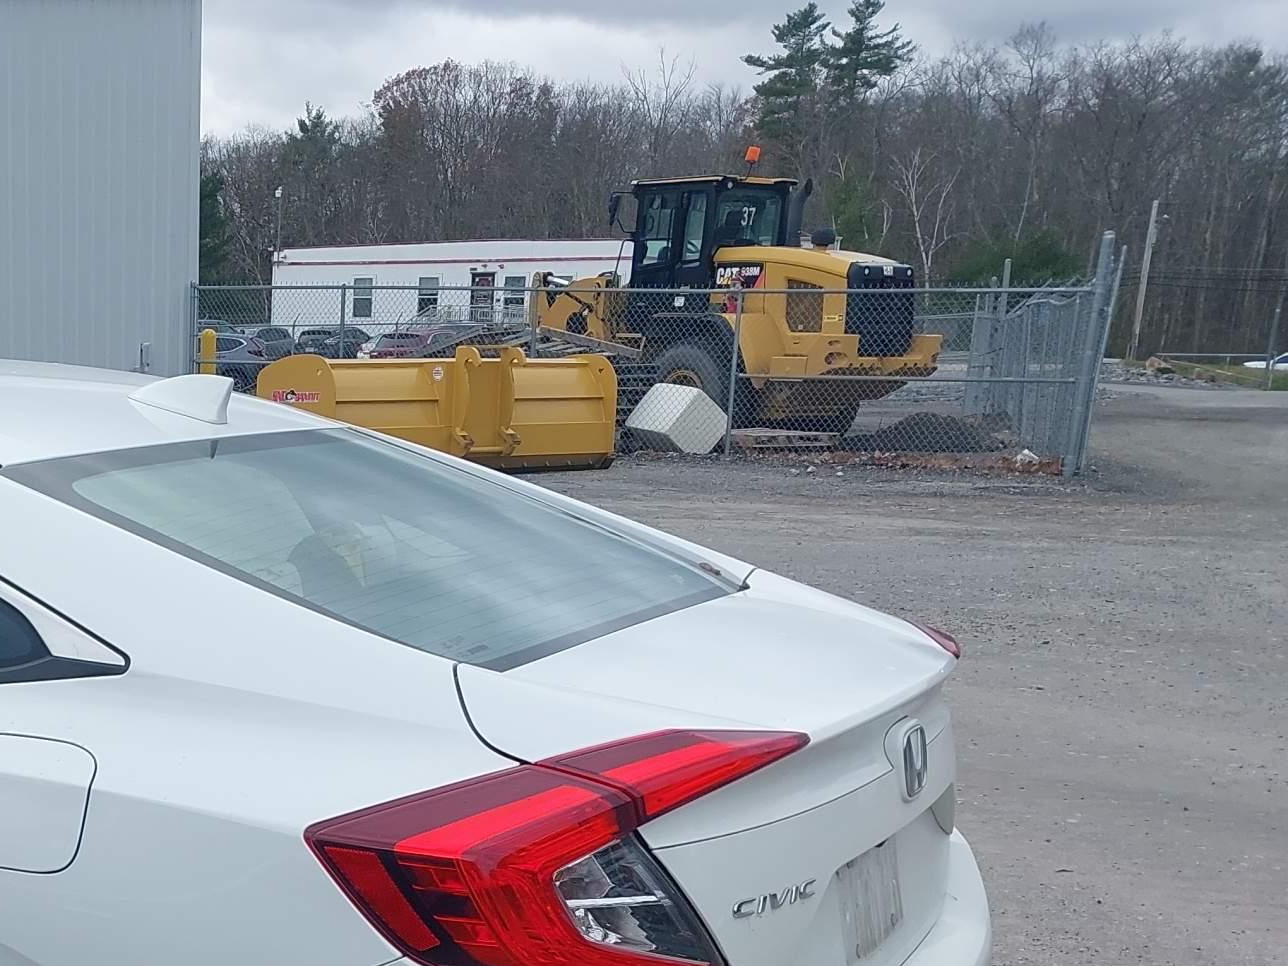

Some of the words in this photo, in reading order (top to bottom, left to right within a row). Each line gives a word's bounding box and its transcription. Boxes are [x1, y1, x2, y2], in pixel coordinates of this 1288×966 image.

[741, 206, 757, 226] 37
[716, 267, 740, 285] CAT
[732, 879, 817, 919] CIVIC
